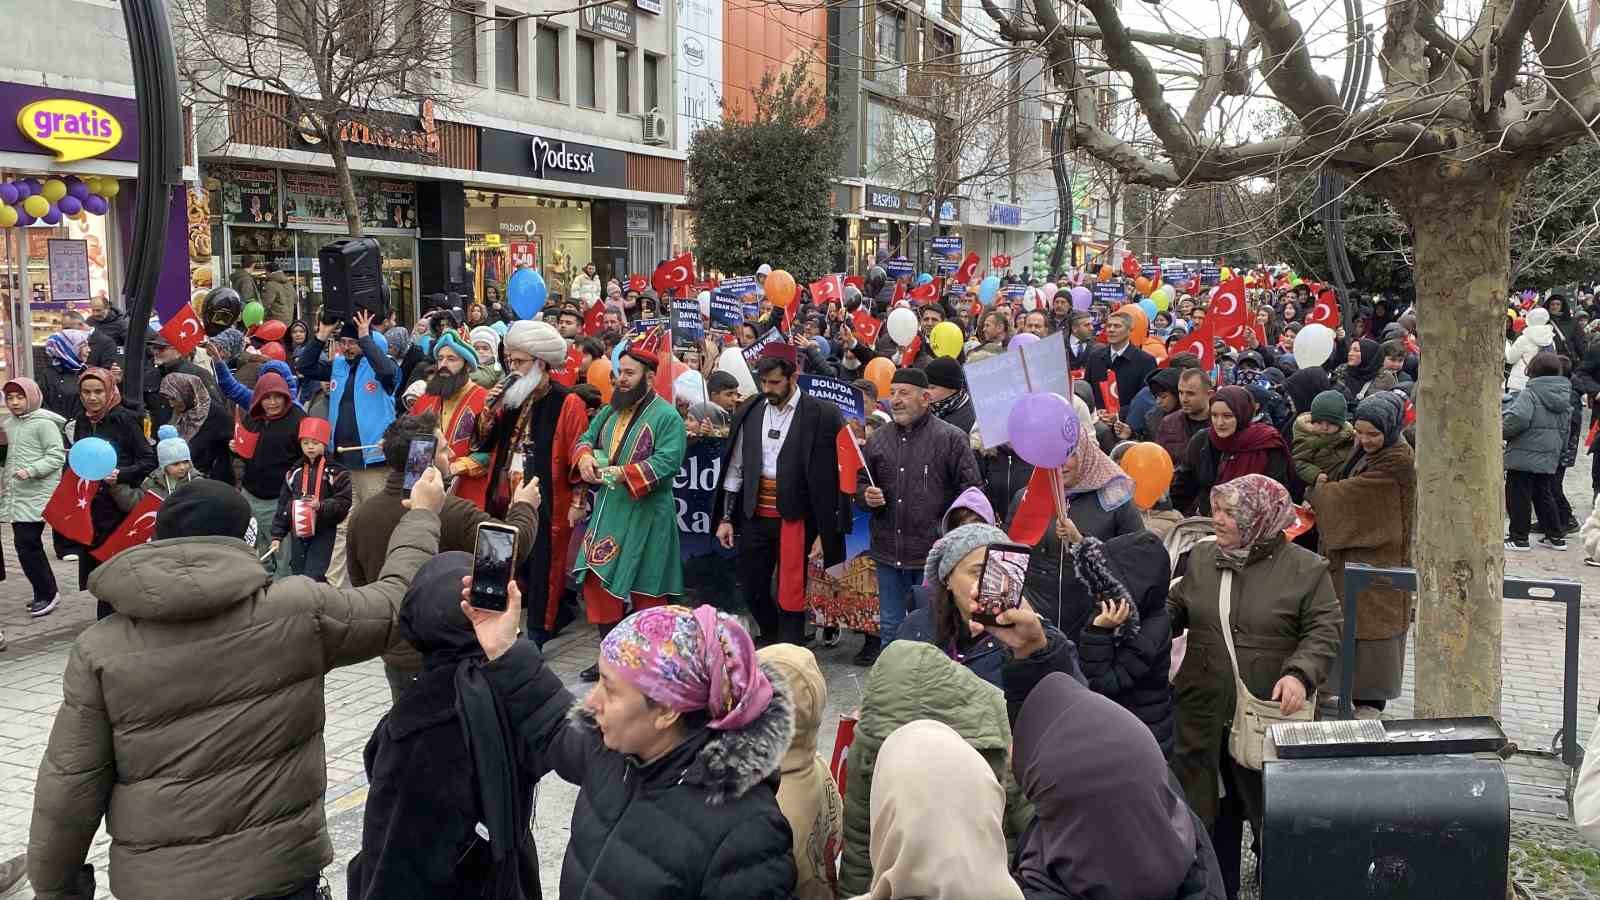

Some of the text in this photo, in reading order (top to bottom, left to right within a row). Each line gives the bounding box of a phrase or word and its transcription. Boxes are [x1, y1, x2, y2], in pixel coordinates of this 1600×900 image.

[601, 5, 627, 22] AVUKAT
[34, 110, 112, 138] gratis
[808, 389, 856, 407] RAMAZAN
[672, 456, 721, 491] eld
[672, 497, 710, 533] Ra
